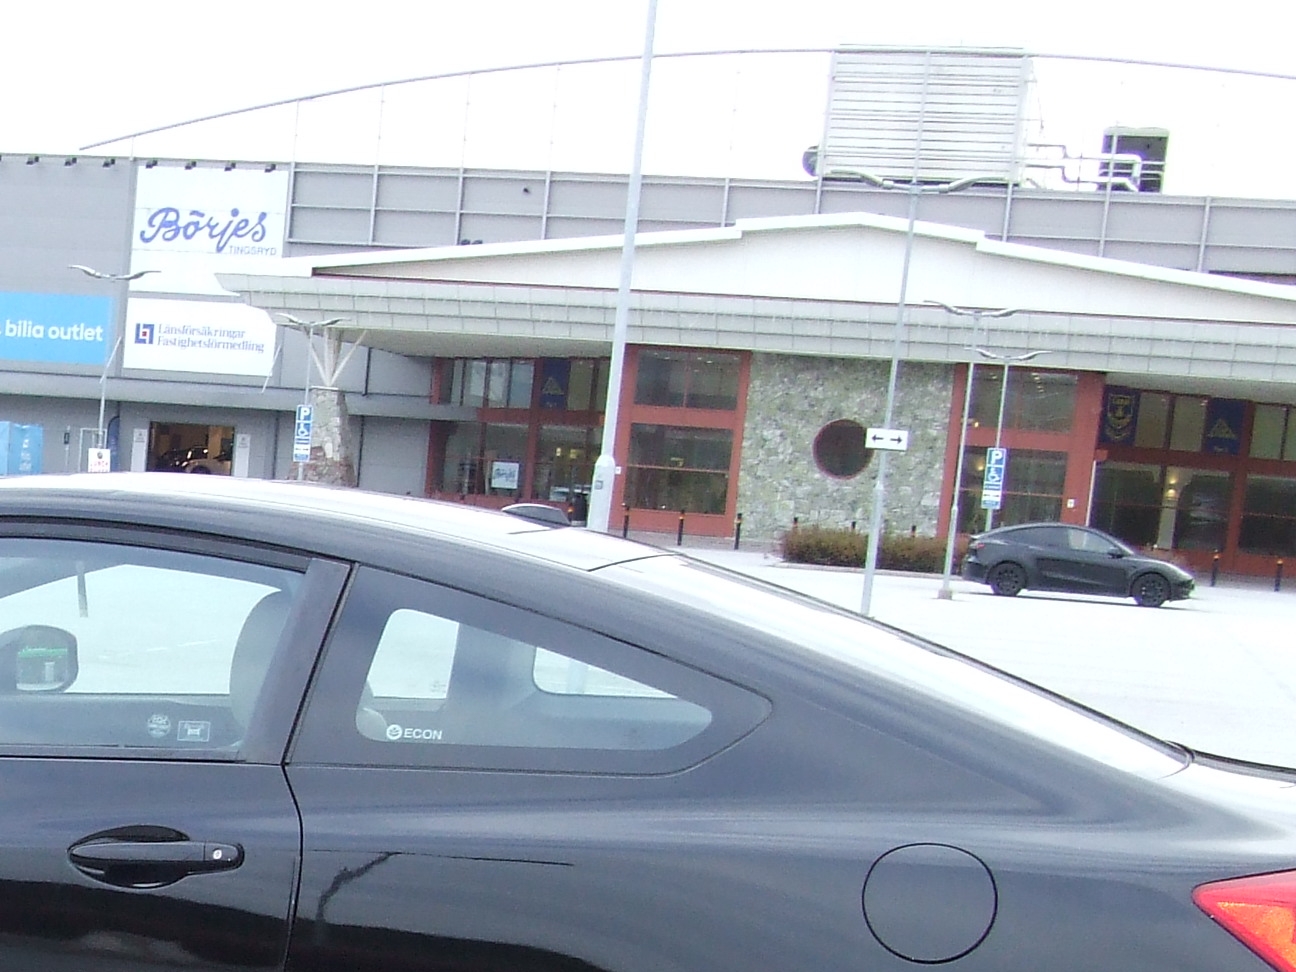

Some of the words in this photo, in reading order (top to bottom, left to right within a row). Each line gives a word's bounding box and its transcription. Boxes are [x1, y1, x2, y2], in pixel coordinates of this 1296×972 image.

[139, 206, 267, 253] Börjes
[5, 319, 44, 338] bilia
[48, 323, 103, 342] outlet
[158, 323, 246, 340] Länsförsäkringar
[157, 336, 265, 353] Fastighetsförmedling
[300, 407, 310, 421] P
[990, 450, 1002, 465] P
[403, 728, 443, 740] ECON
